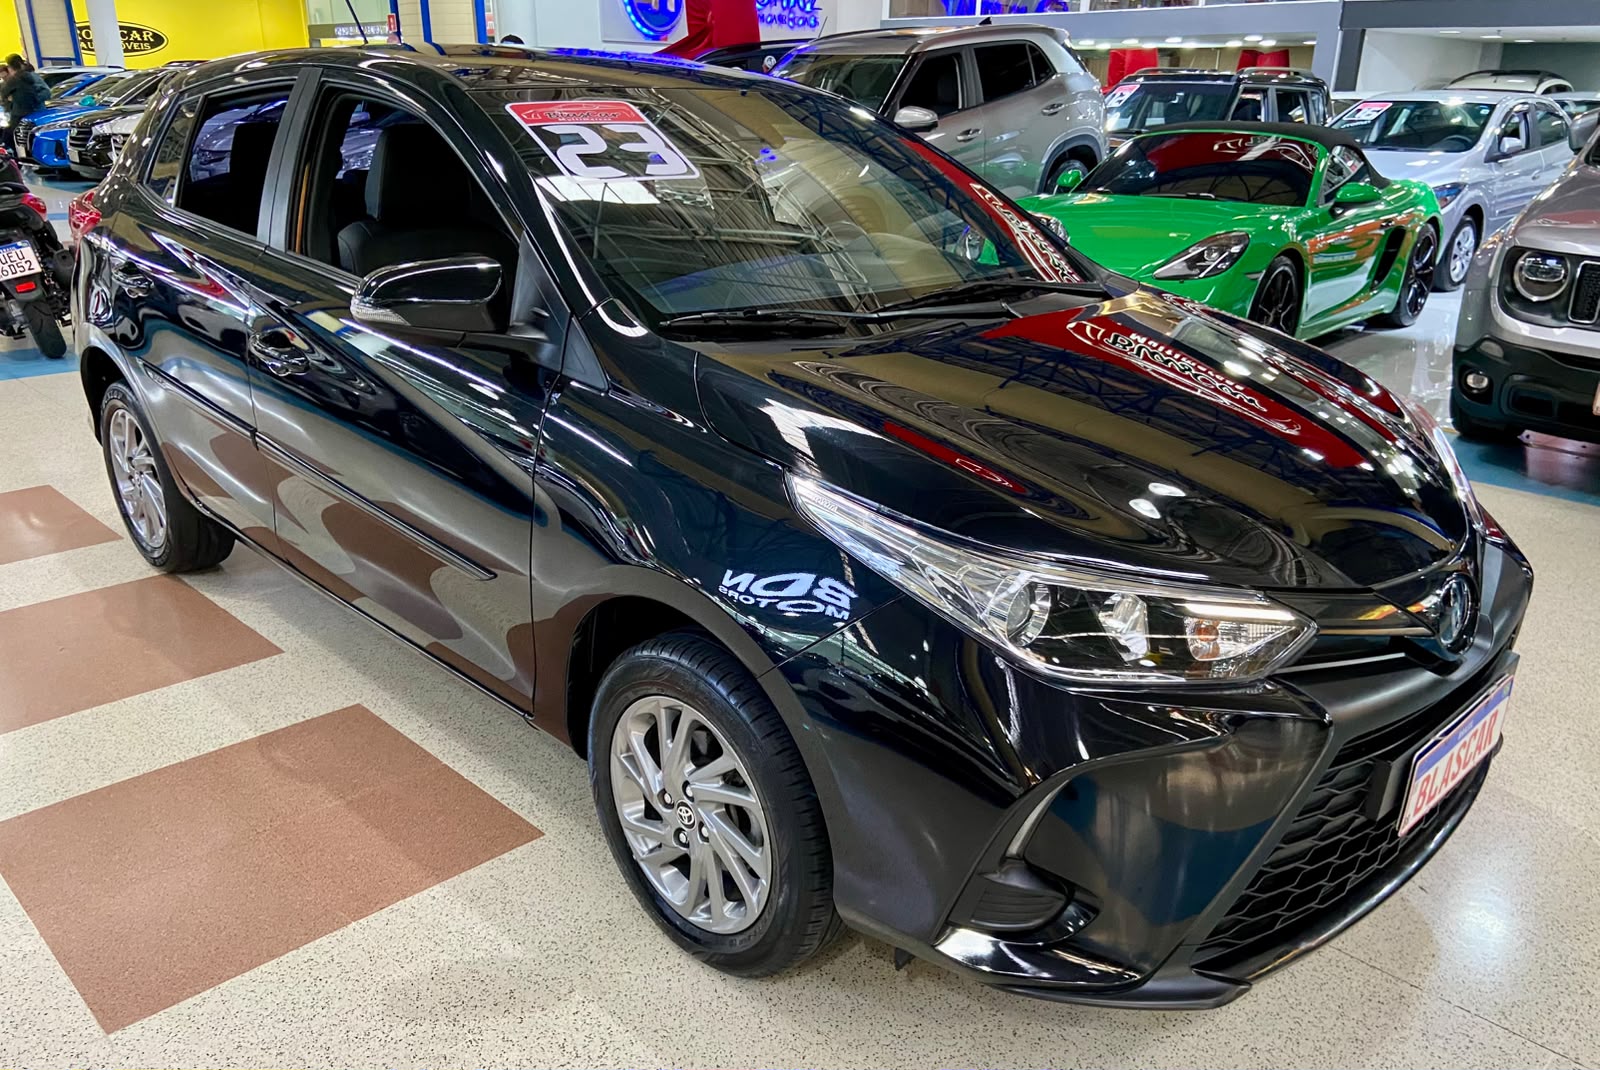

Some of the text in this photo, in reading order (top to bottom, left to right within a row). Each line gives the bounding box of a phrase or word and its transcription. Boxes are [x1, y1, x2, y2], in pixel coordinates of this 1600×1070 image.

[541, 125, 687, 177] 23
[1, 260, 34, 276] 6D52
[1413, 709, 1499, 815] BLASCAR
